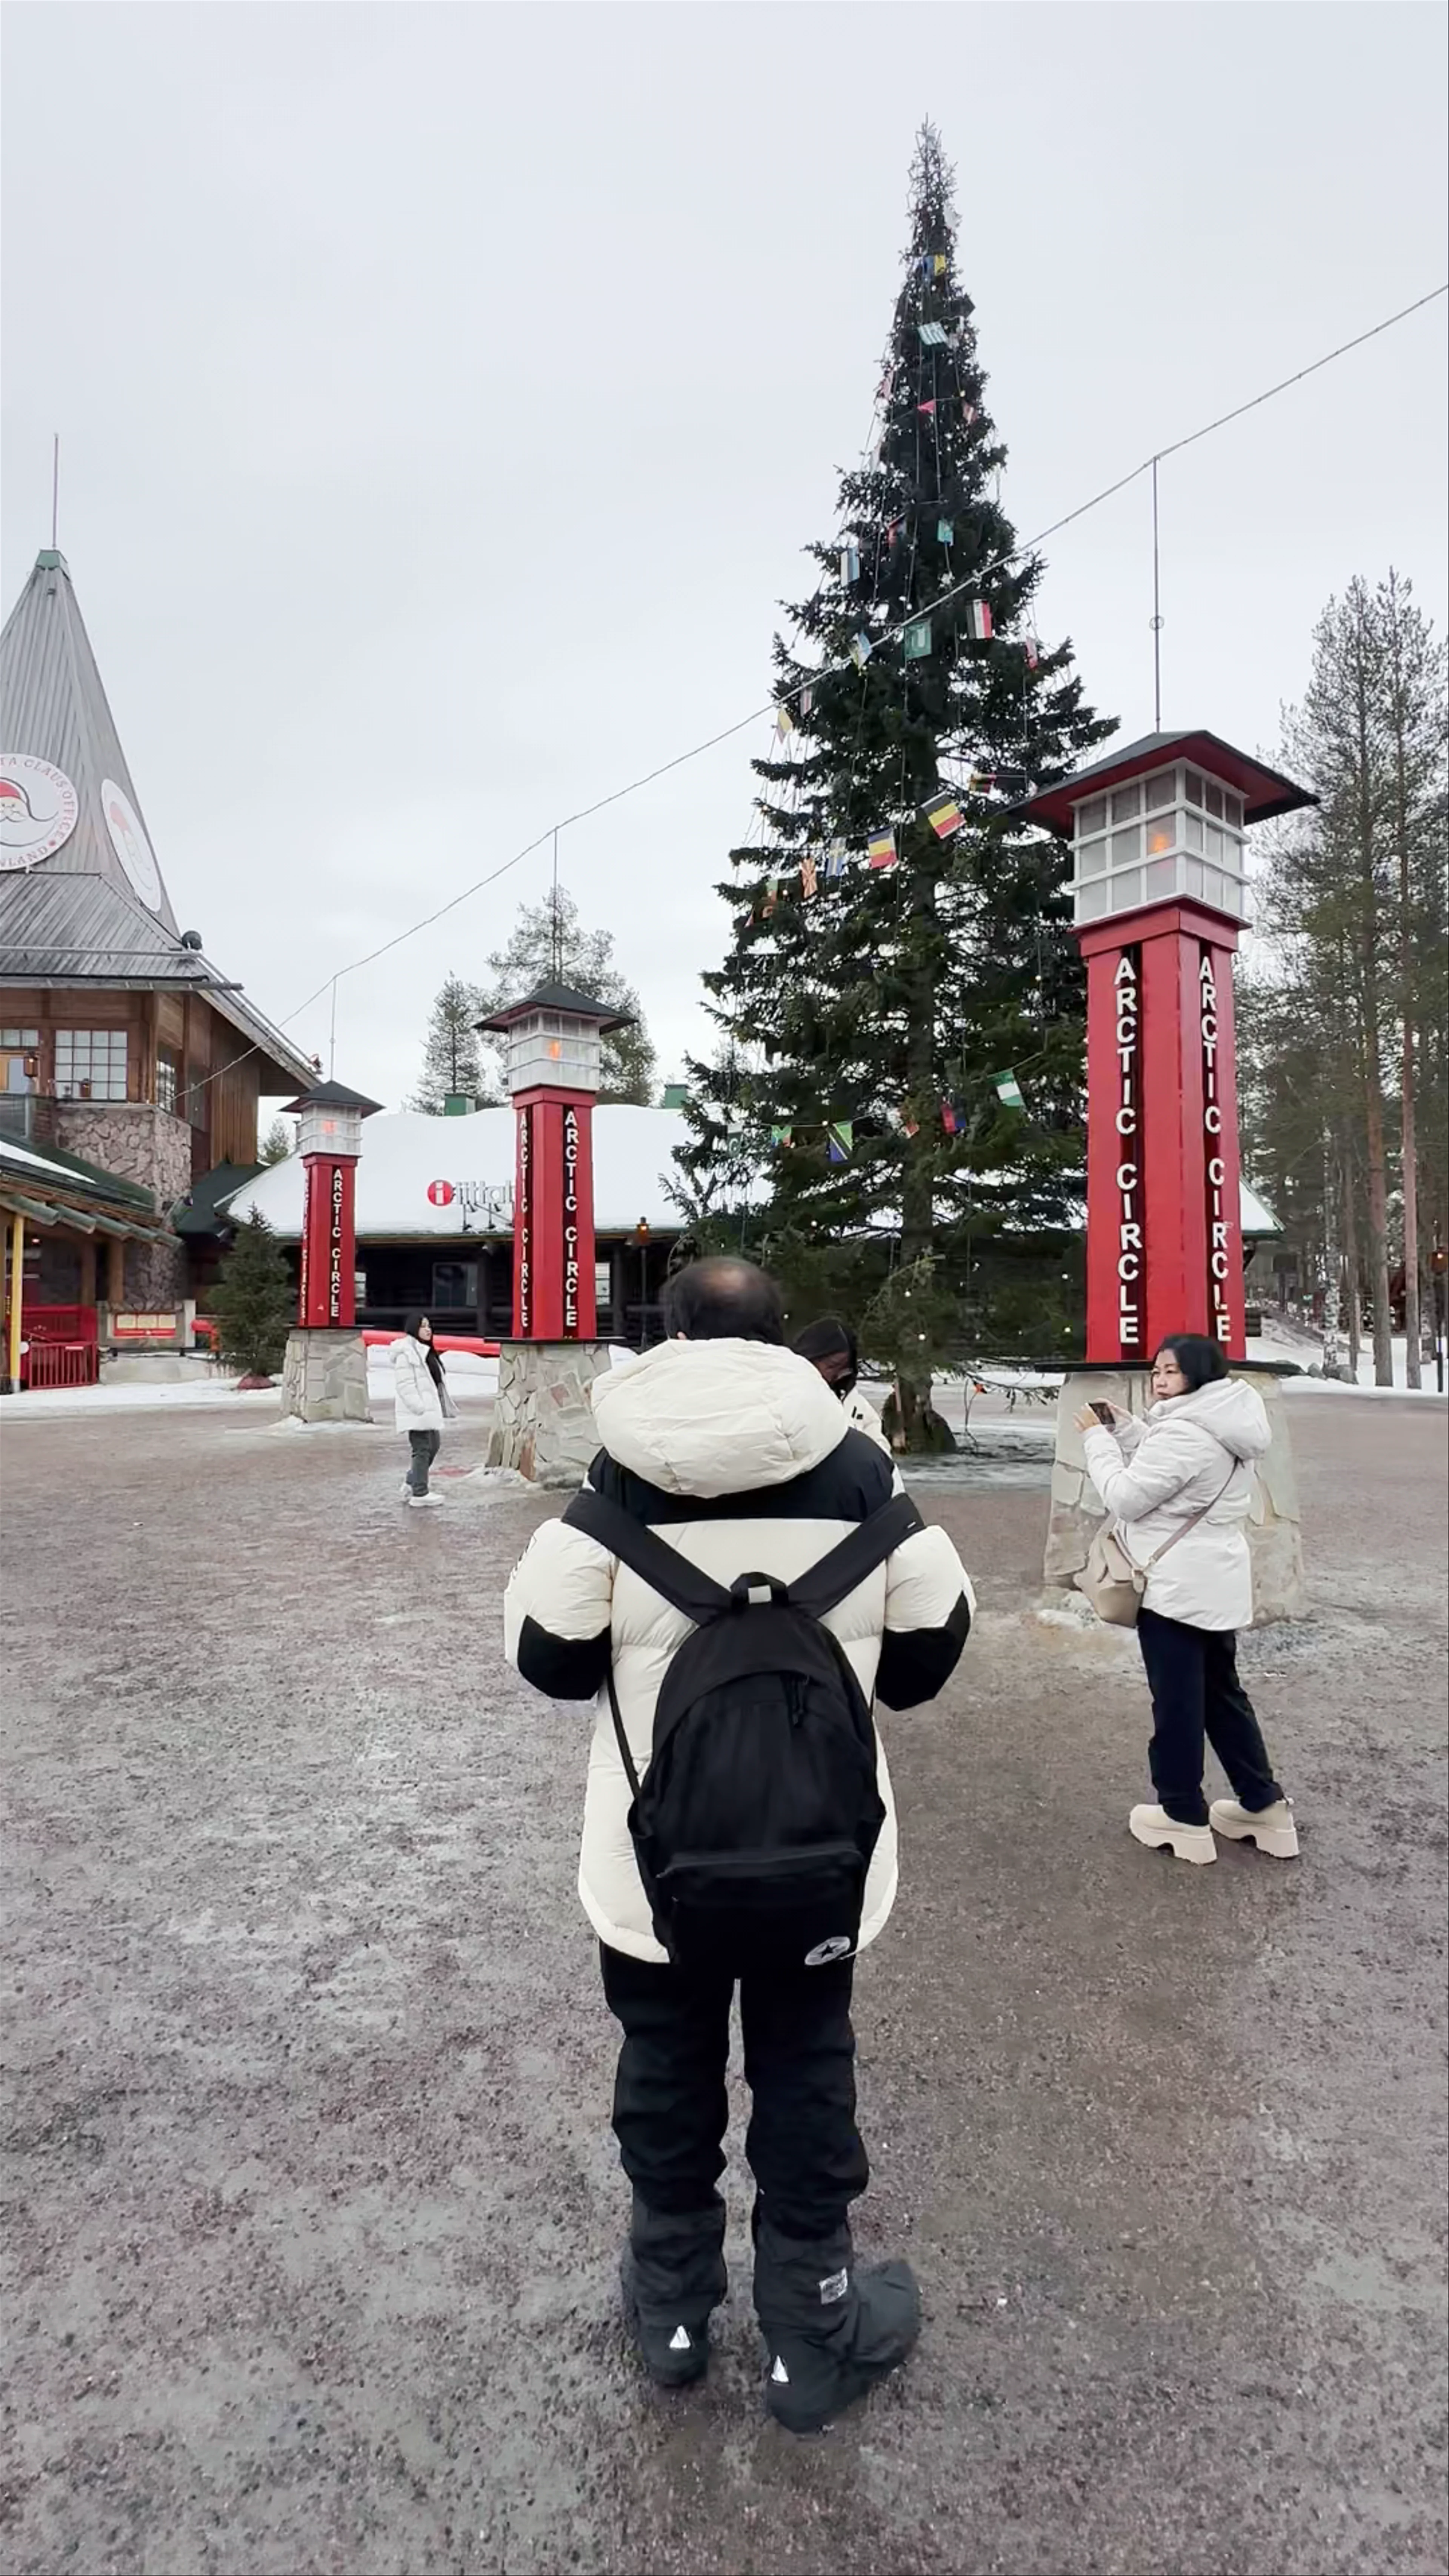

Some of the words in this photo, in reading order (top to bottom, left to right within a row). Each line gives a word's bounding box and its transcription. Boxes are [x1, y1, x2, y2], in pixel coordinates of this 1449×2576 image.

[24, 759, 68, 788] CLAUS
[1114, 957, 1137, 1134] ARCTIC
[1199, 956, 1221, 1133] ARCTIC
[332, 1169, 343, 1238] ARCTIC
[520, 1112, 528, 1213] ARCTIC
[565, 1110, 579, 1211] ARCTIC
[331, 1248, 341, 1317] CIRCLE
[566, 1226, 578, 1326] CIRCLE
[1116, 1163, 1143, 1343] CIRCLE
[1209, 1158, 1232, 1341] CIRCLE
